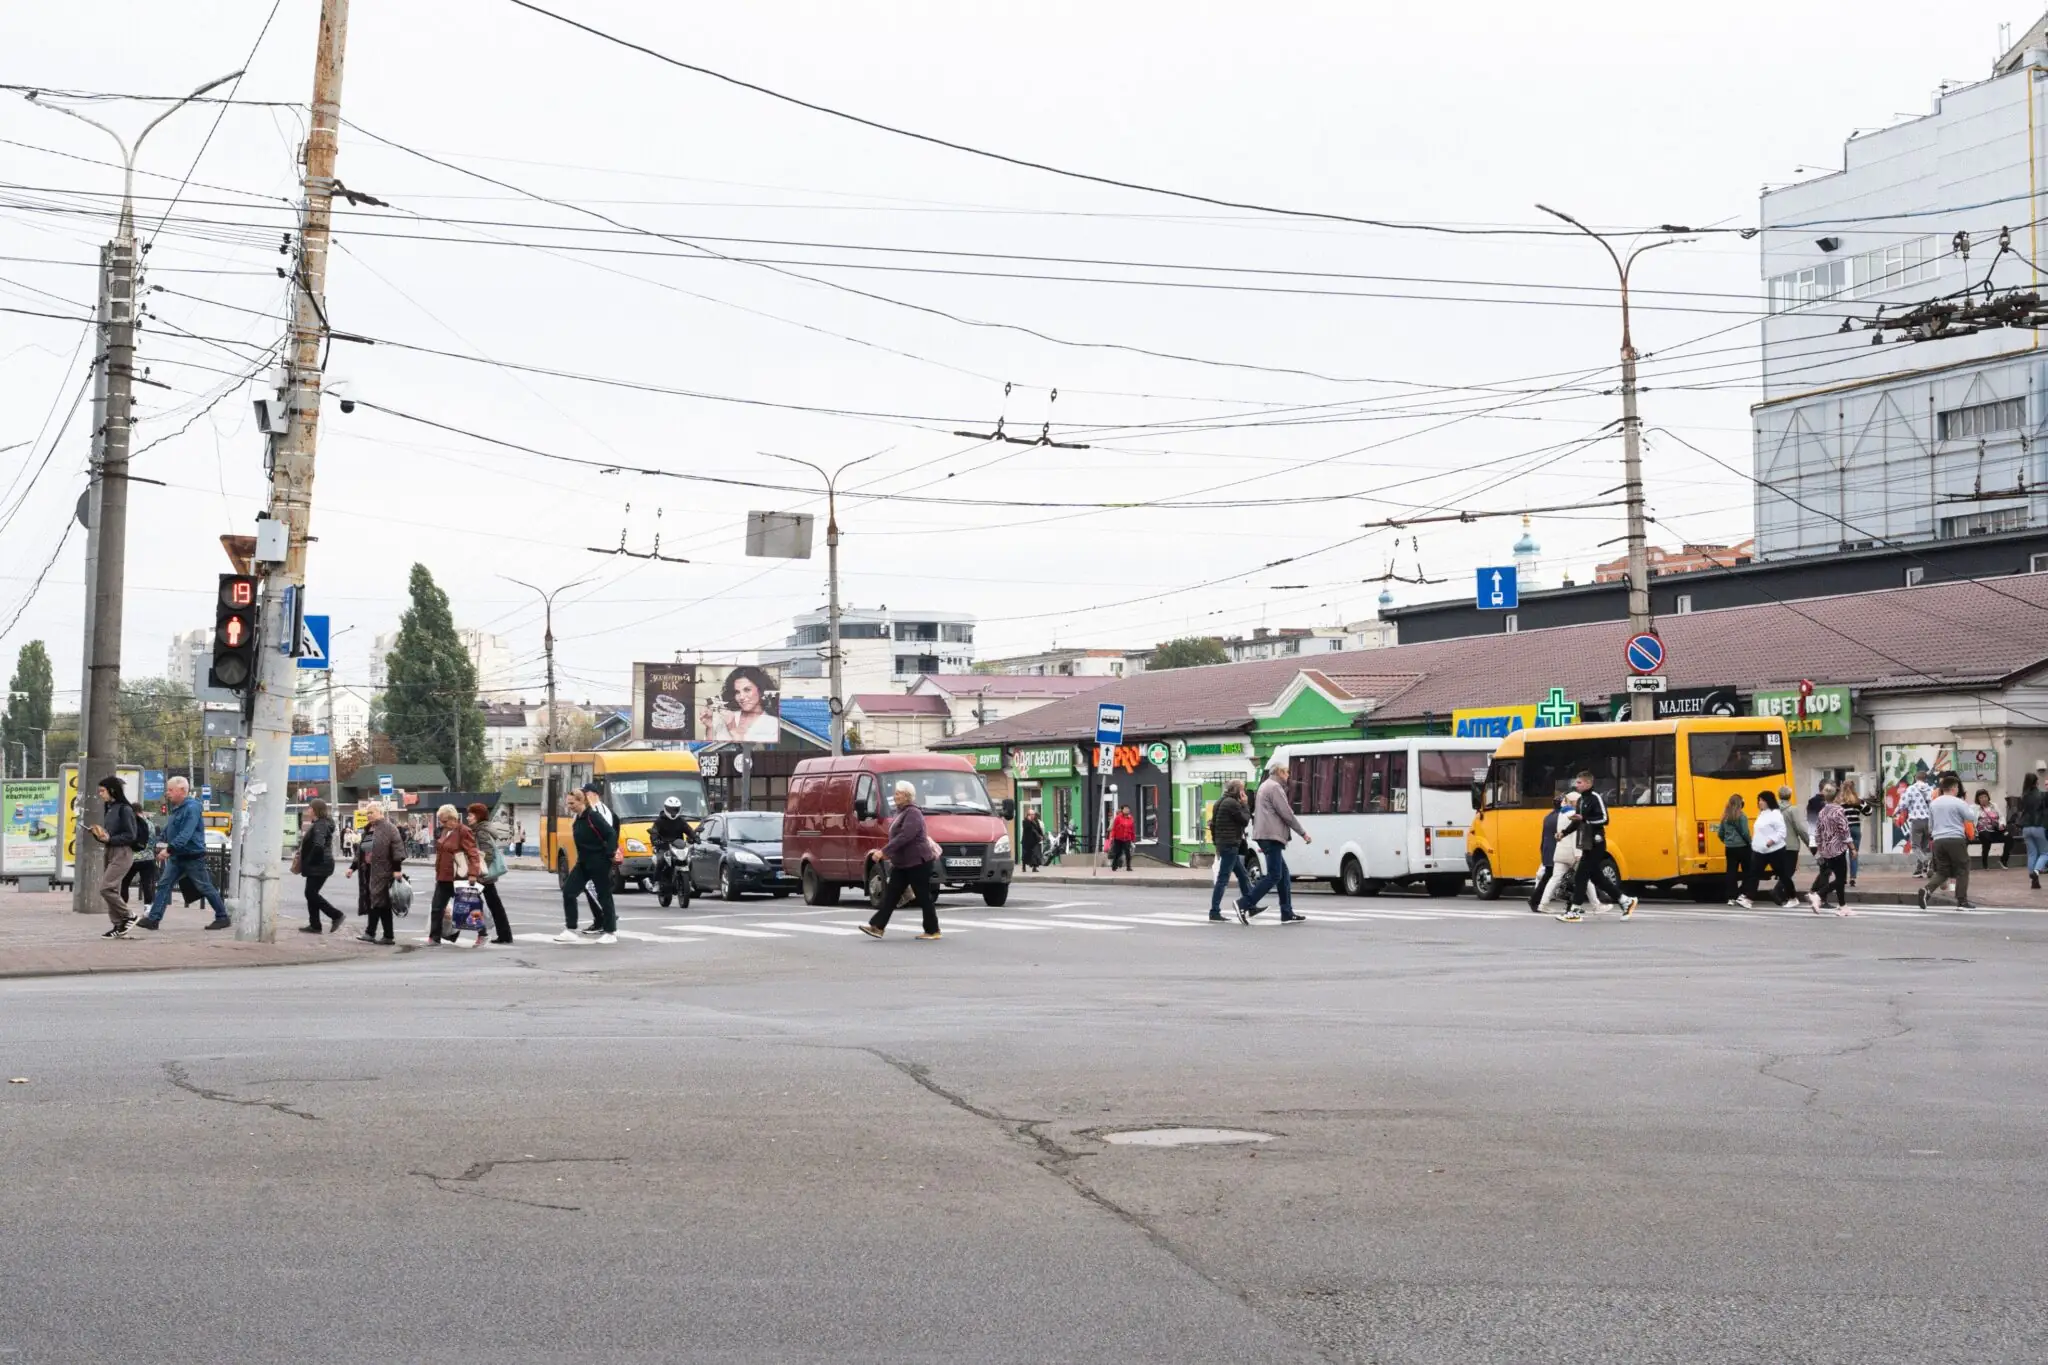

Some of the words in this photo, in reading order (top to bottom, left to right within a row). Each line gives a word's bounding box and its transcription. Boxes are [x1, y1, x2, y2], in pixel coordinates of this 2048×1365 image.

[233, 583, 250, 603] 19
[1456, 715, 1524, 738] АПТЕКА
[1786, 718, 1823, 733] ВІТИ
[1100, 758, 1112, 767] 30
[1395, 792, 1406, 809] 12
